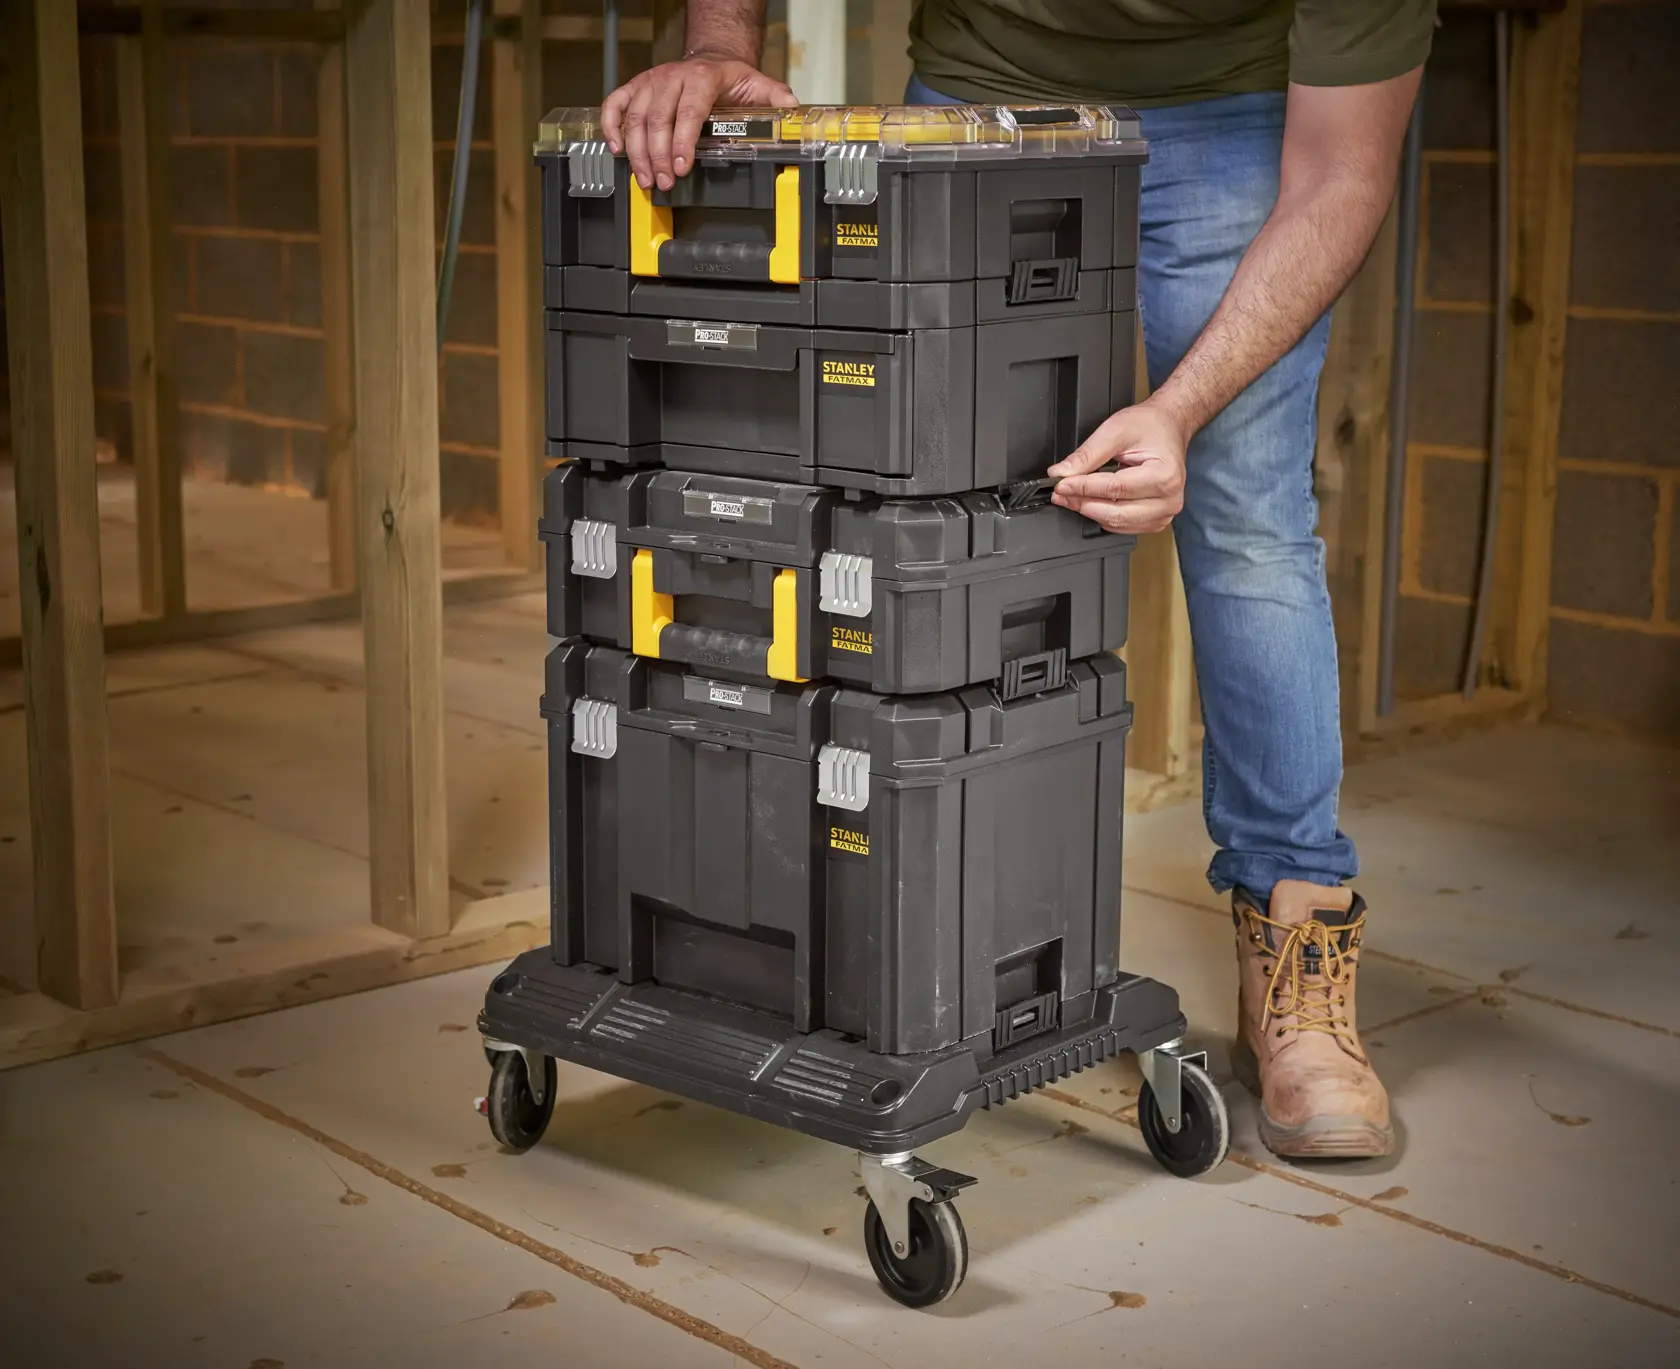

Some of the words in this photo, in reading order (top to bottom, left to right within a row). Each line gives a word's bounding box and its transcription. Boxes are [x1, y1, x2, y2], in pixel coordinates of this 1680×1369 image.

[712, 122, 747, 134] PRO-STACK
[694, 328, 729, 341] PRO-STACK
[823, 361, 875, 376] STANLEY
[828, 375, 869, 385] FATMAX
[710, 500, 744, 514] PRO-STACK
[837, 641, 873, 653] FATMA
[709, 687, 743, 704] PRO-STACK
[830, 827, 869, 846] STANL
